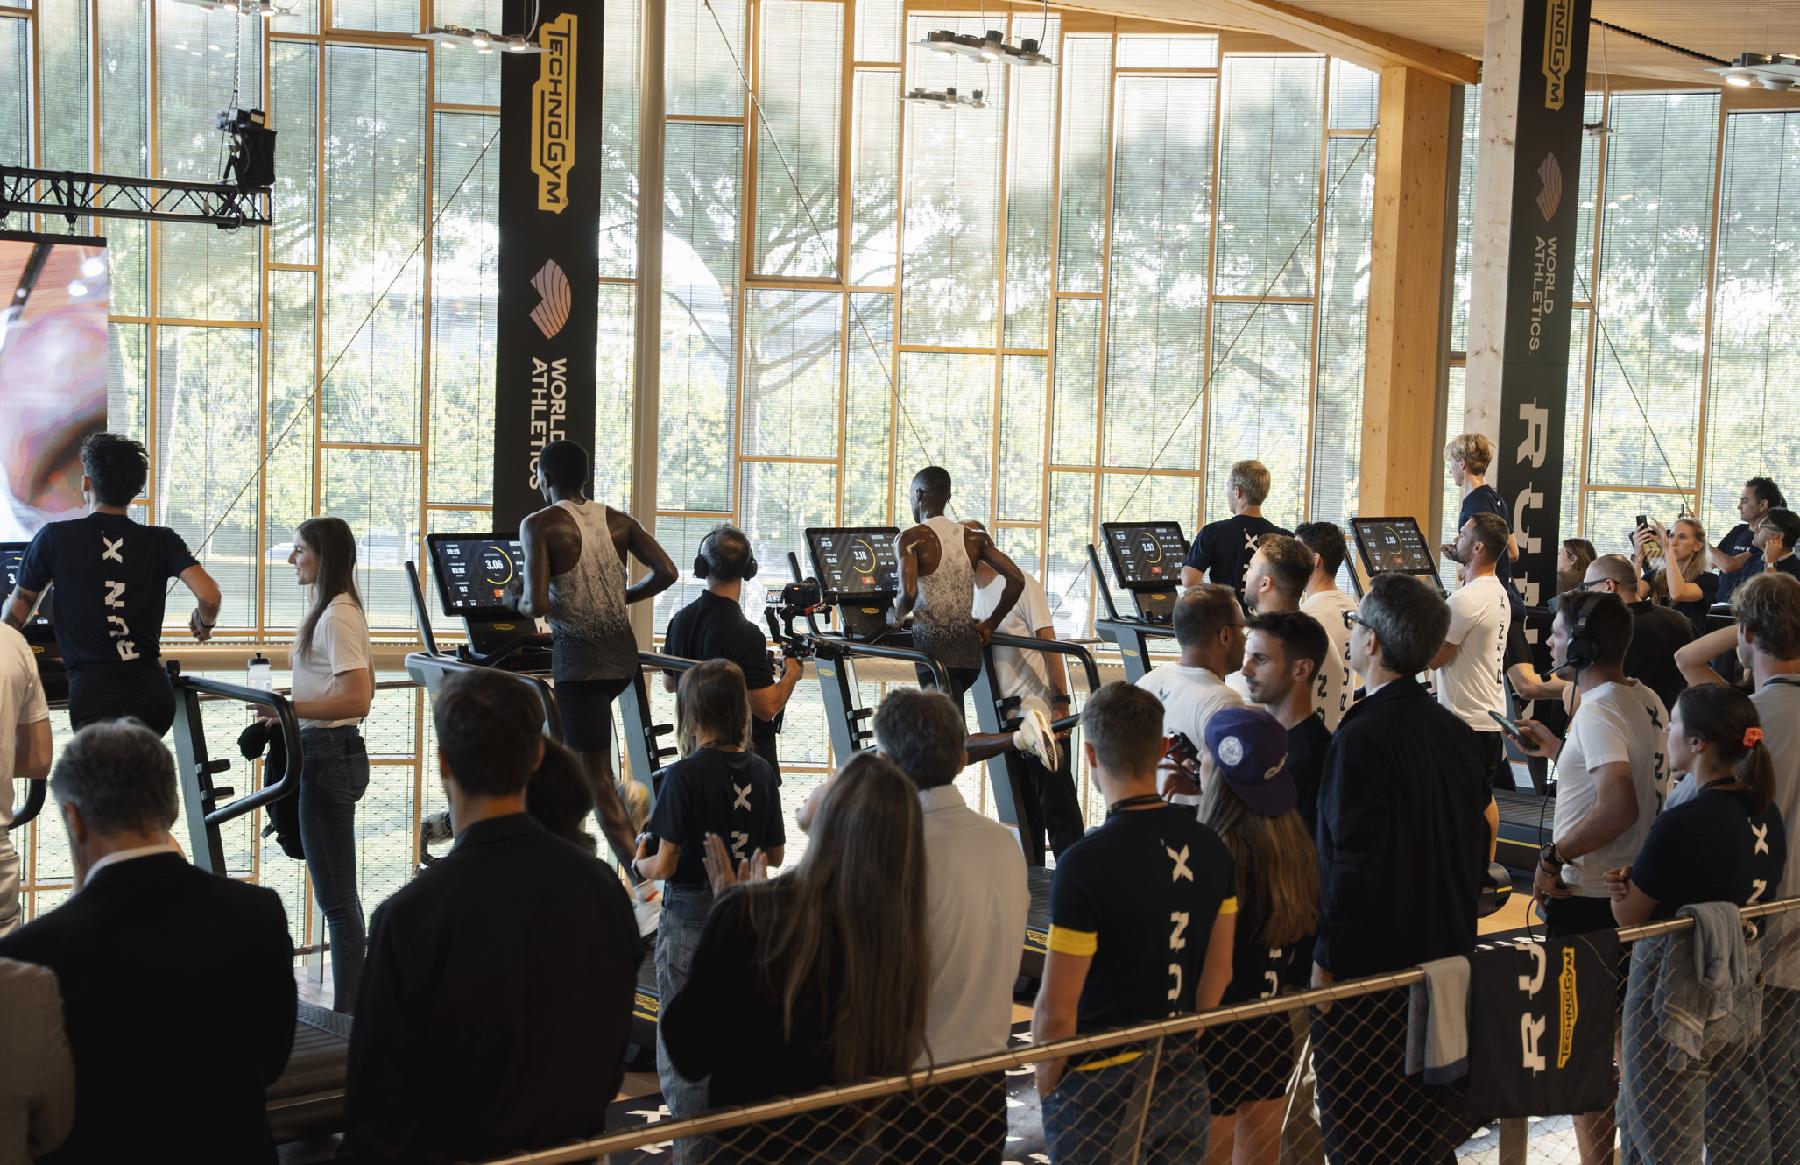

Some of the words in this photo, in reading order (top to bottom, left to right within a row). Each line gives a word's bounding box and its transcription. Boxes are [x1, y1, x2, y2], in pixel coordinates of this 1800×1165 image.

[537, 19, 572, 204] TECHNOGYM
[1529, 236, 1546, 351] ATHLETICS
[1544, 237, 1558, 315] WORLD
[102, 535, 124, 564] X
[104, 580, 141, 662] RUN
[732, 782, 753, 812] X
[1165, 844, 1195, 883] X
[1751, 822, 1769, 856] X
[1167, 911, 1191, 1018] UN
[1514, 942, 1546, 1077] RU
[1558, 951, 1577, 1068] TECHNOGYM
